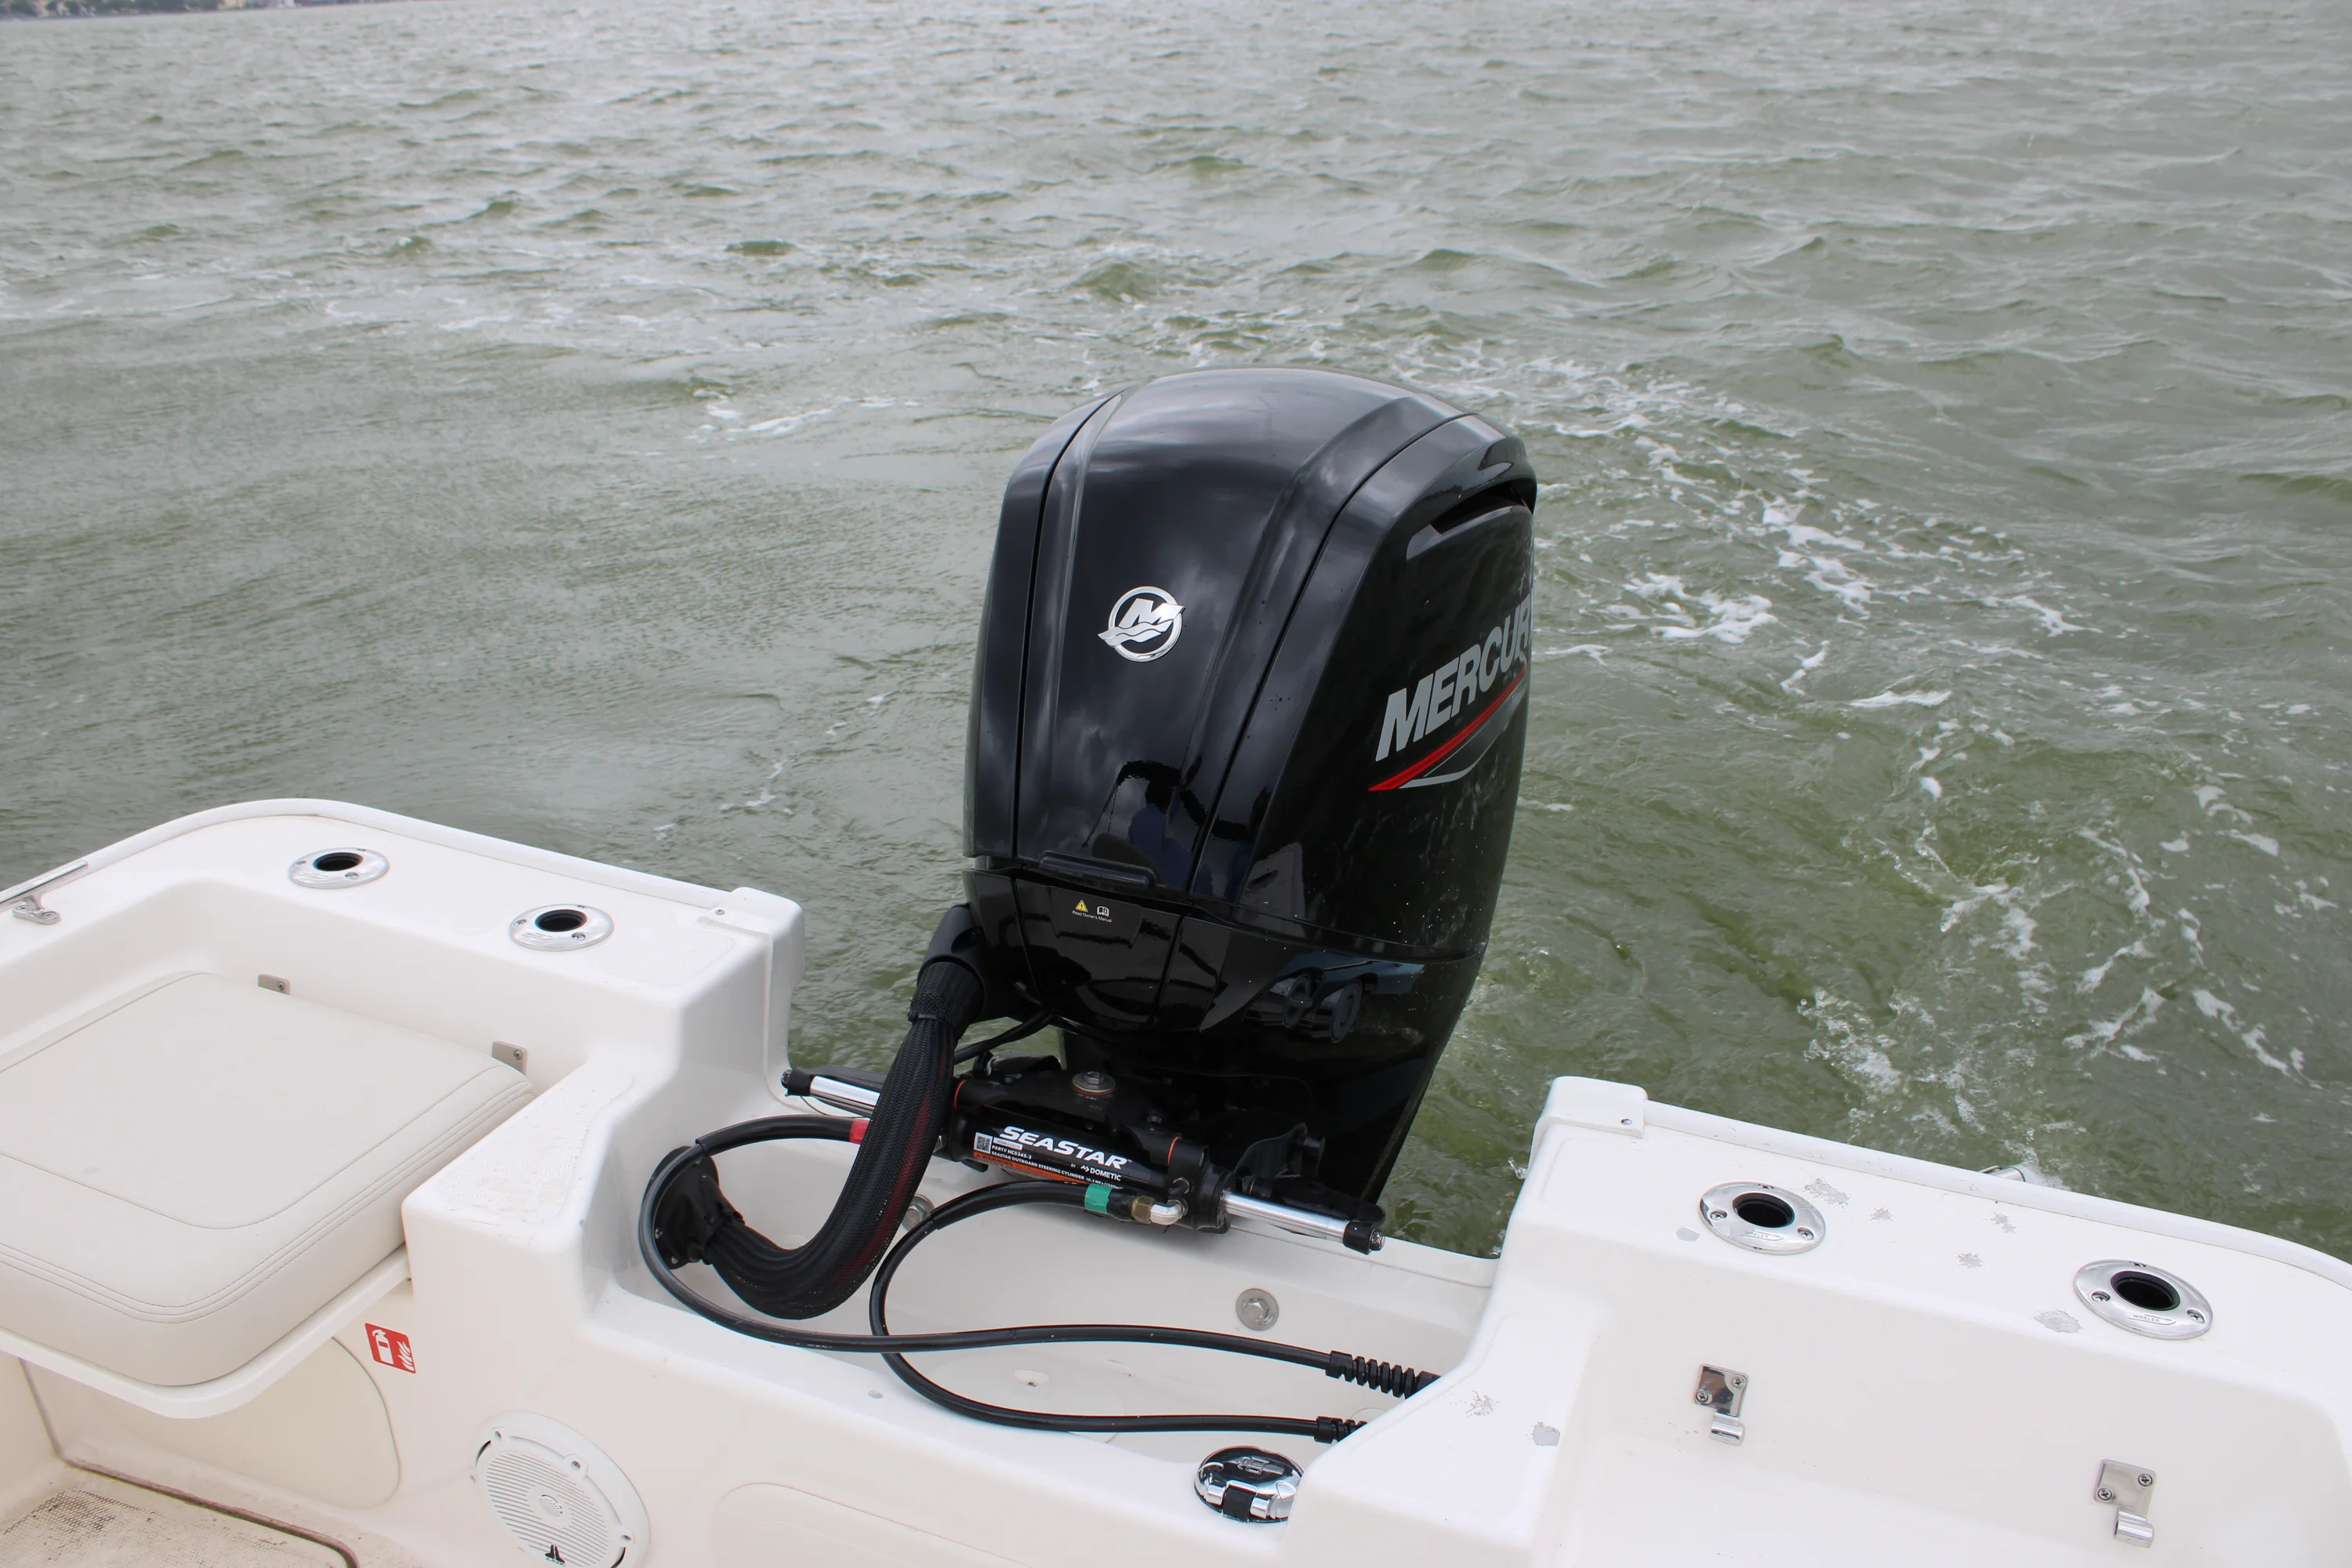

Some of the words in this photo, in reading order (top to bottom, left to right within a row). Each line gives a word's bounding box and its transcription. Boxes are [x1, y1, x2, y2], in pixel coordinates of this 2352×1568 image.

[991, 1151, 1011, 1160] SEASTAR
[1011, 1156, 1038, 1167] OUTBOARD
[1038, 1163, 1061, 1174] STEERING
[1061, 1171, 1084, 1180] CYLINDER
[1090, 1167, 1121, 1181] DOMETIC
[2132, 1314, 2159, 1323] WHALER
